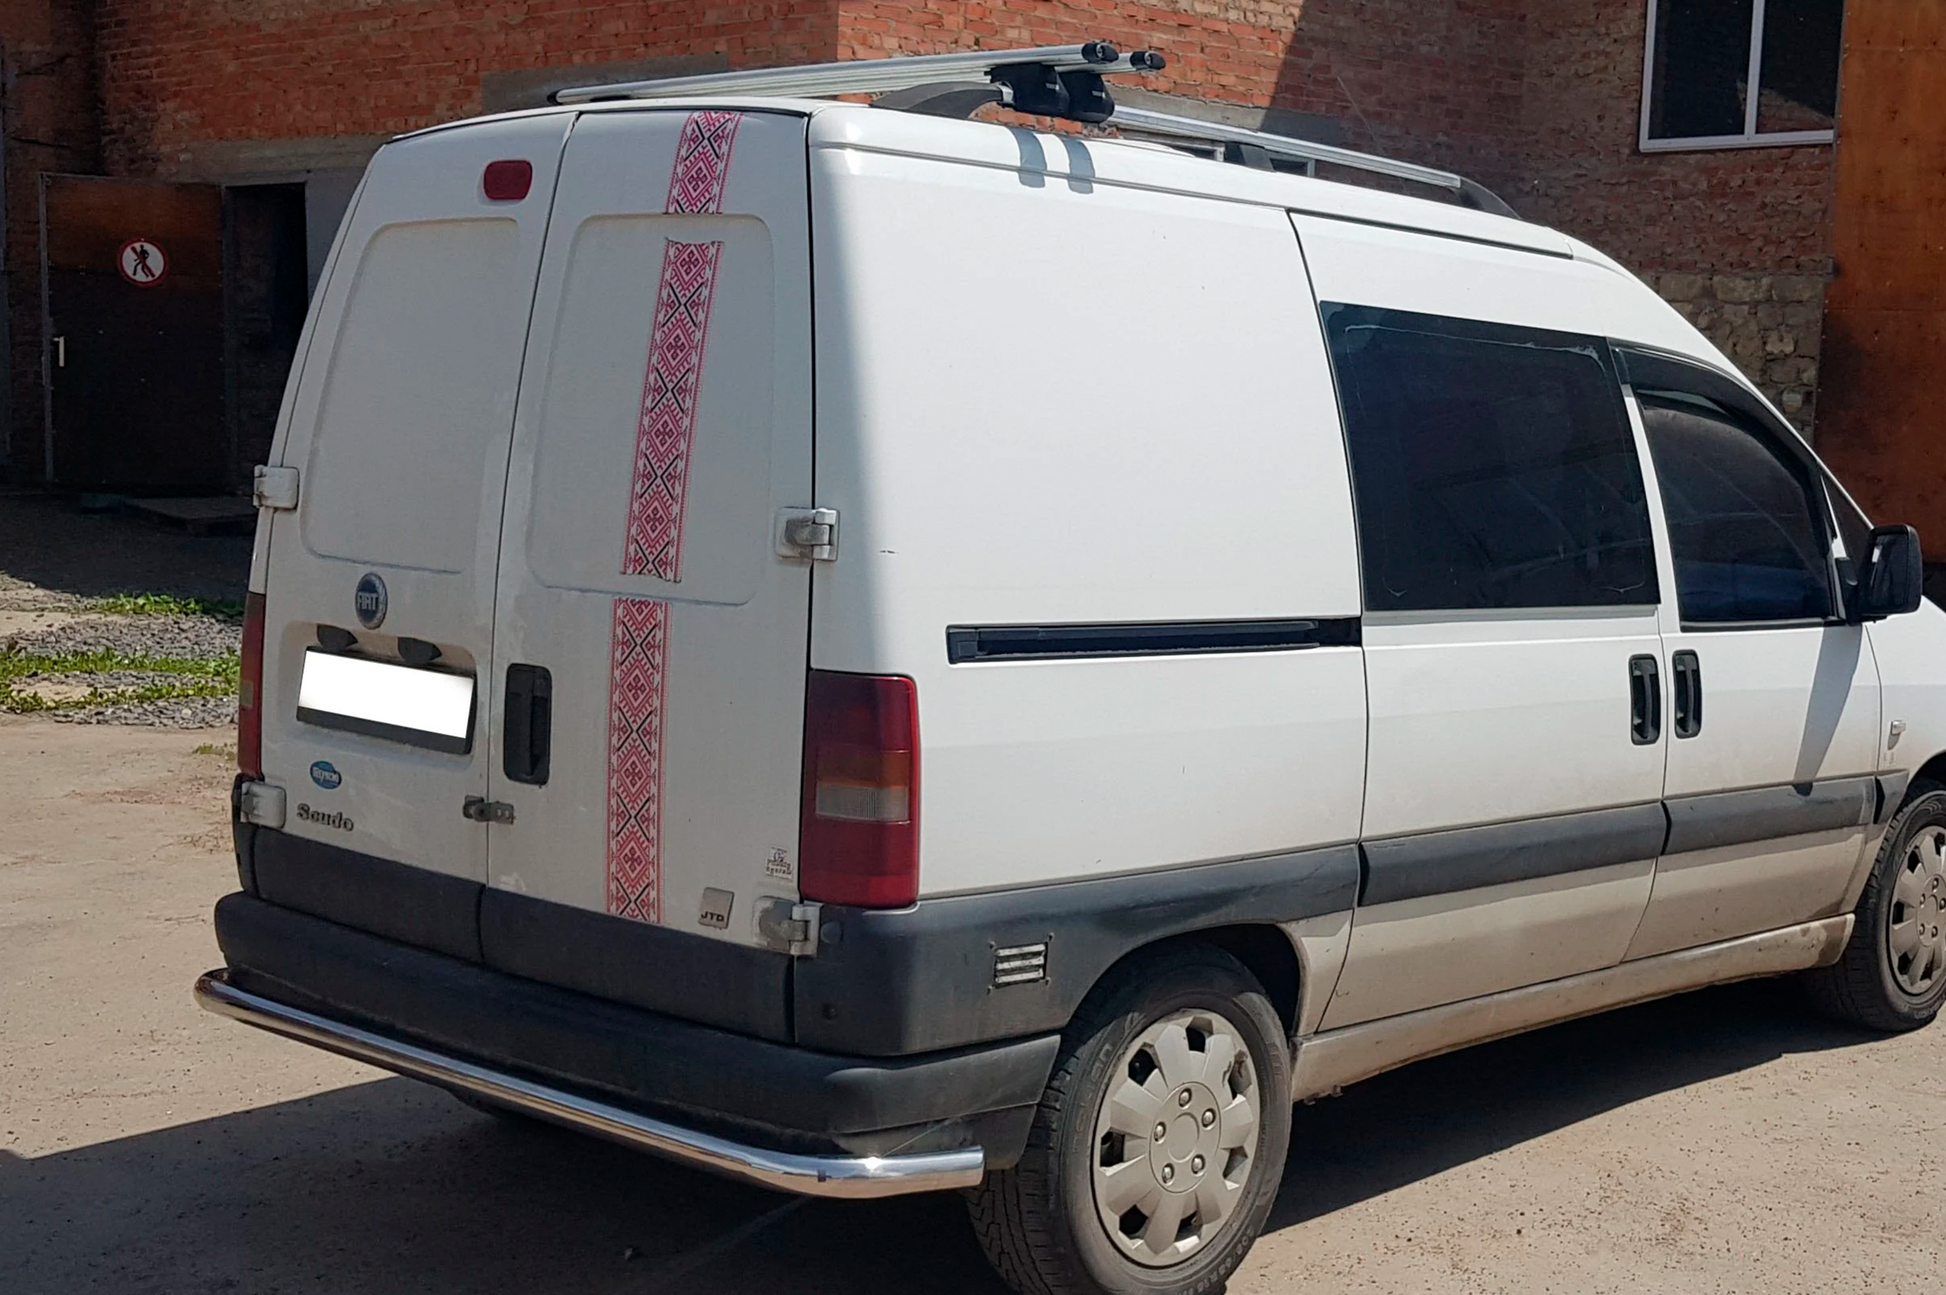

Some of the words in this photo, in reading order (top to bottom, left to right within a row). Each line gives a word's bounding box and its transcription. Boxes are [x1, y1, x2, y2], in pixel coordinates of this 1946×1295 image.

[357, 591, 379, 610] FIAT
[297, 803, 354, 832] Scudo
[700, 911, 725, 922] JTD
